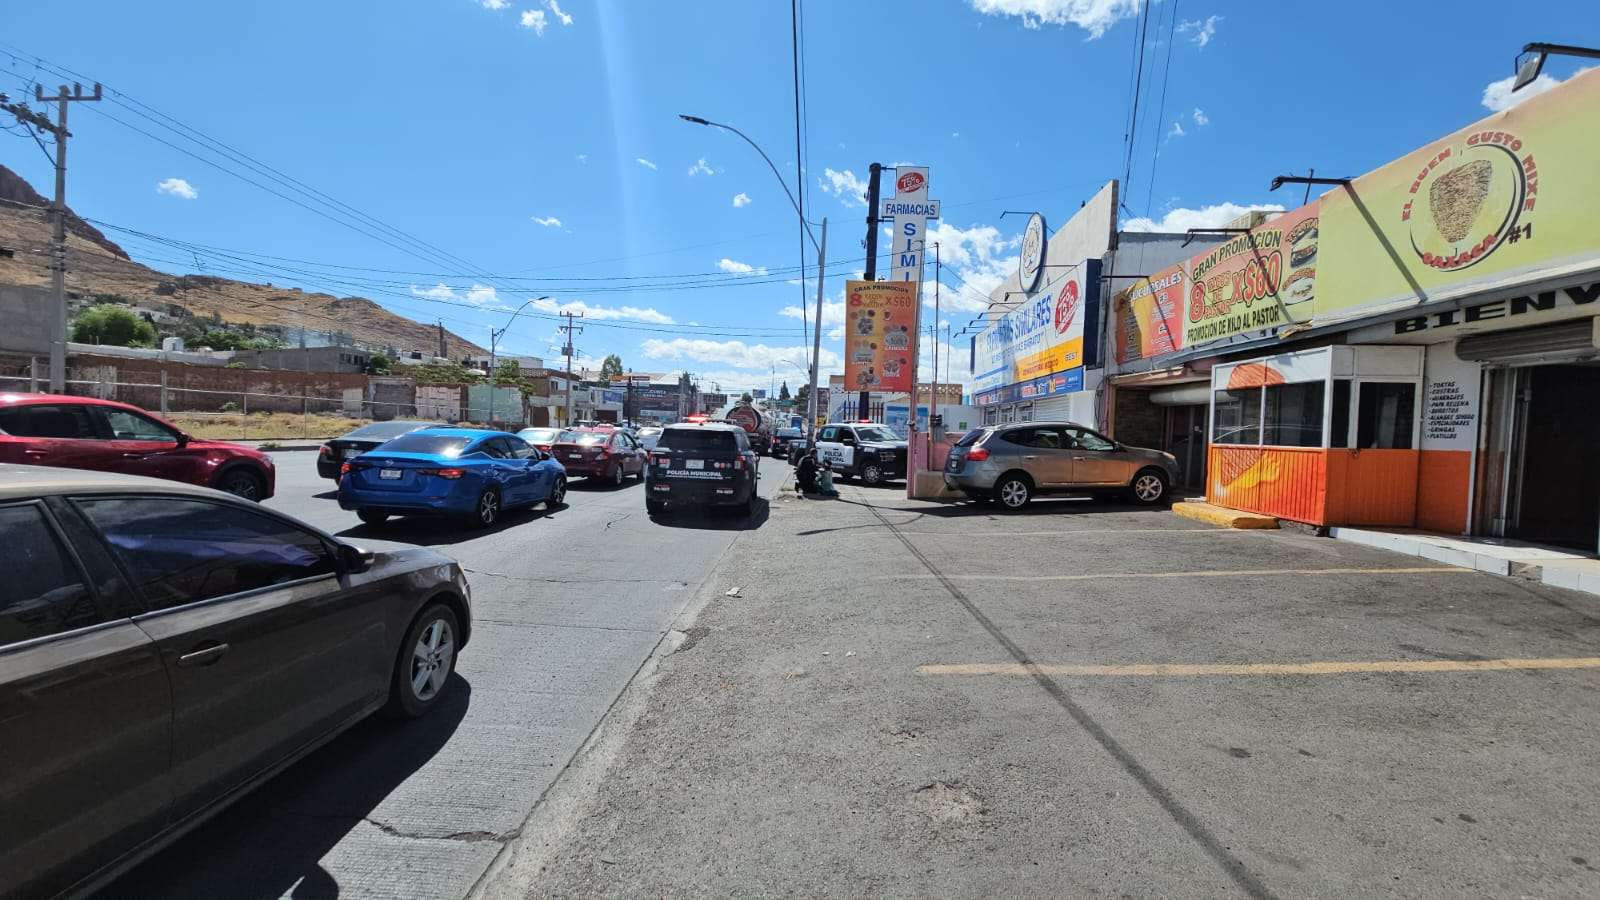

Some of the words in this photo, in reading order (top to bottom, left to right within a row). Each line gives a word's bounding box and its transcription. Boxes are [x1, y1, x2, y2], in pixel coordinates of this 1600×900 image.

[1402, 199, 1413, 221] EL
[1410, 148, 1450, 193] BUEN
[1466, 131, 1522, 151] GUSTO
[1522, 154, 1538, 211] MIXE
[886, 203, 936, 216] FARMACIAS
[1422, 234, 1498, 269] OAXACA
[1508, 222, 1532, 244] #1
[1192, 252, 1217, 281] GRAN
[1219, 231, 1282, 261] PROMOCION
[1190, 281, 1206, 323] 8
[1187, 322, 1218, 342] PROMOCION
[1218, 319, 1226, 334] DE
[1242, 313, 1251, 329] AL
[1252, 304, 1280, 327] PASTOR
